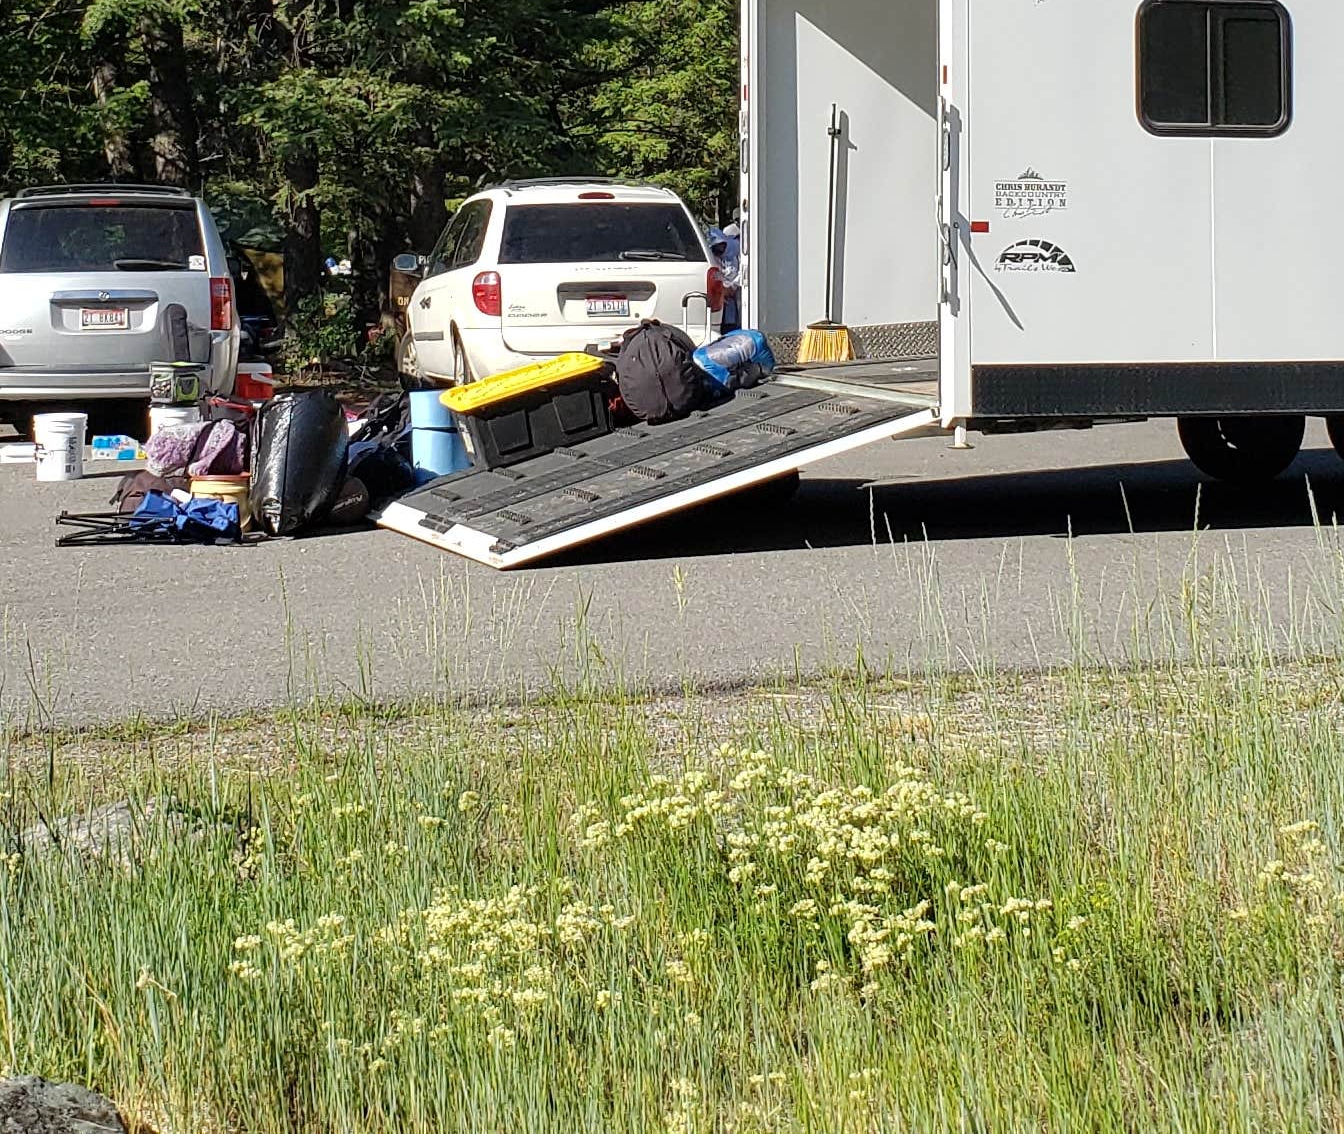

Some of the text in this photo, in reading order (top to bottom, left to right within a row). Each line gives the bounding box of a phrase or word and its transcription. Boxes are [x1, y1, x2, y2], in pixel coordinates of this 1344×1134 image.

[995, 183, 1023, 191] CHRIS
[995, 198, 1067, 207] EDITION
[999, 252, 1062, 264] RPM
[1001, 263, 1039, 272] Trails
